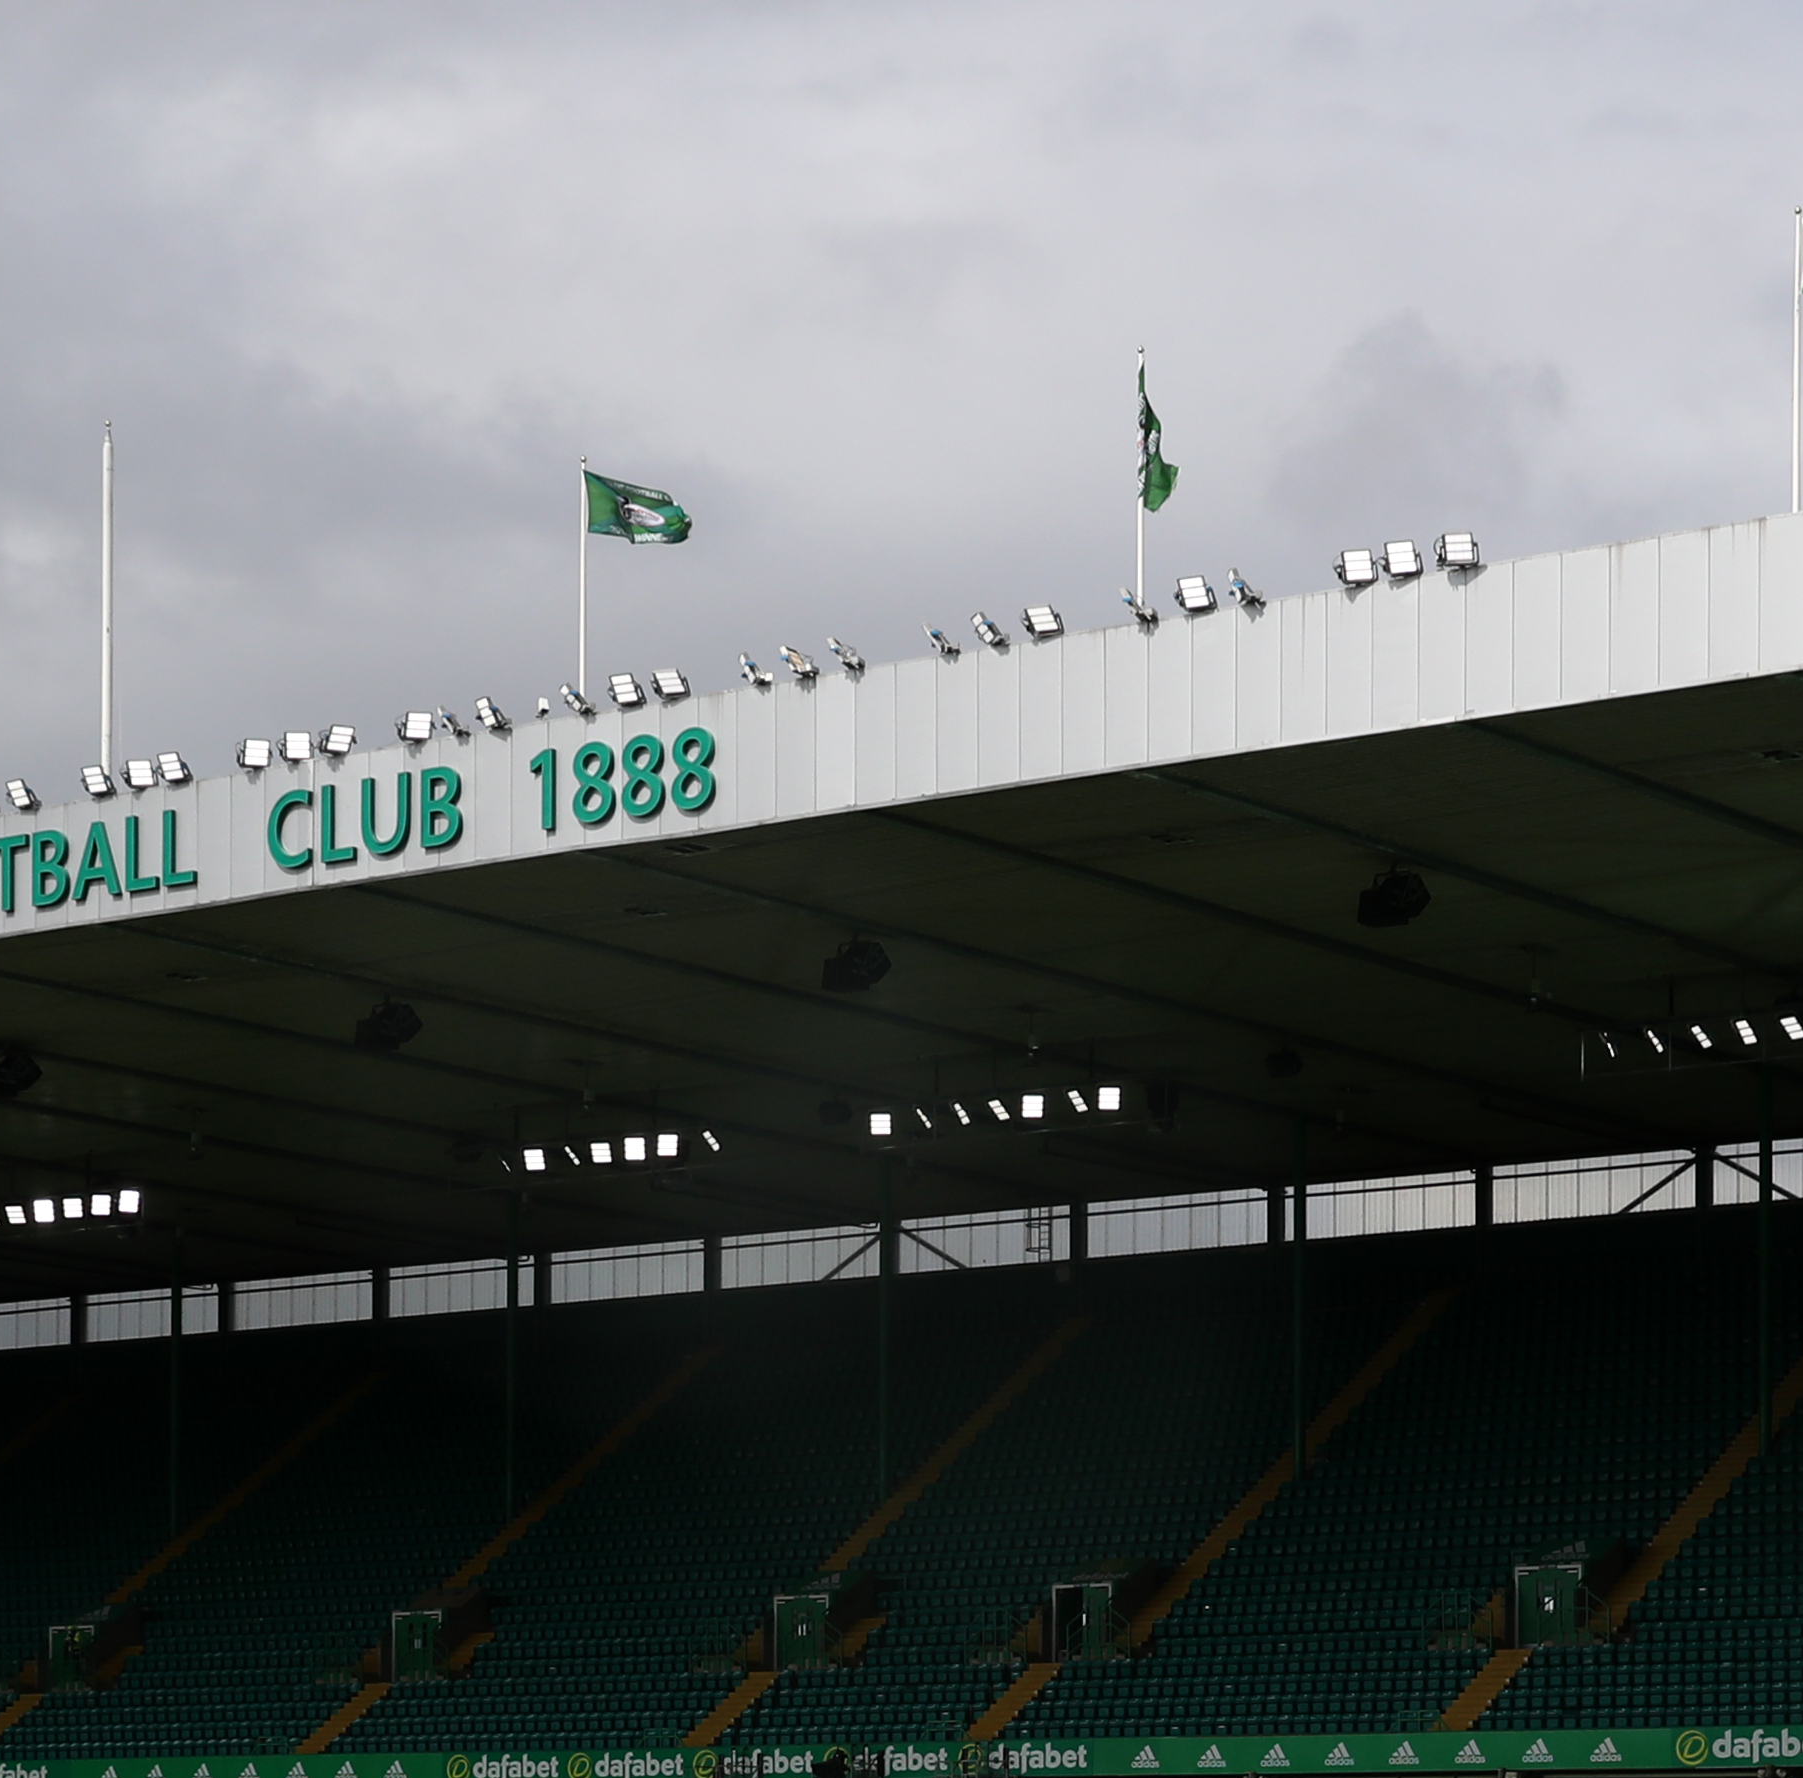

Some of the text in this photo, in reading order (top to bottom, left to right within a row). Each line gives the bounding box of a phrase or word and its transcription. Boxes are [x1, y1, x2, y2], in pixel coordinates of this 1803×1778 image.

[267, 765, 463, 869] CLUB
[529, 727, 717, 832] 1888
[1324, 1757, 1354, 1767] adidas
[1389, 1756, 1419, 1766] adidas
[1454, 1754, 1485, 1765] adidas
[1522, 1753, 1554, 1763] adidas
[1590, 1752, 1622, 1762] adidas
[1131, 1760, 1160, 1769] adidas
[1197, 1759, 1227, 1769] adidas
[1260, 1758, 1291, 1768] adidas
